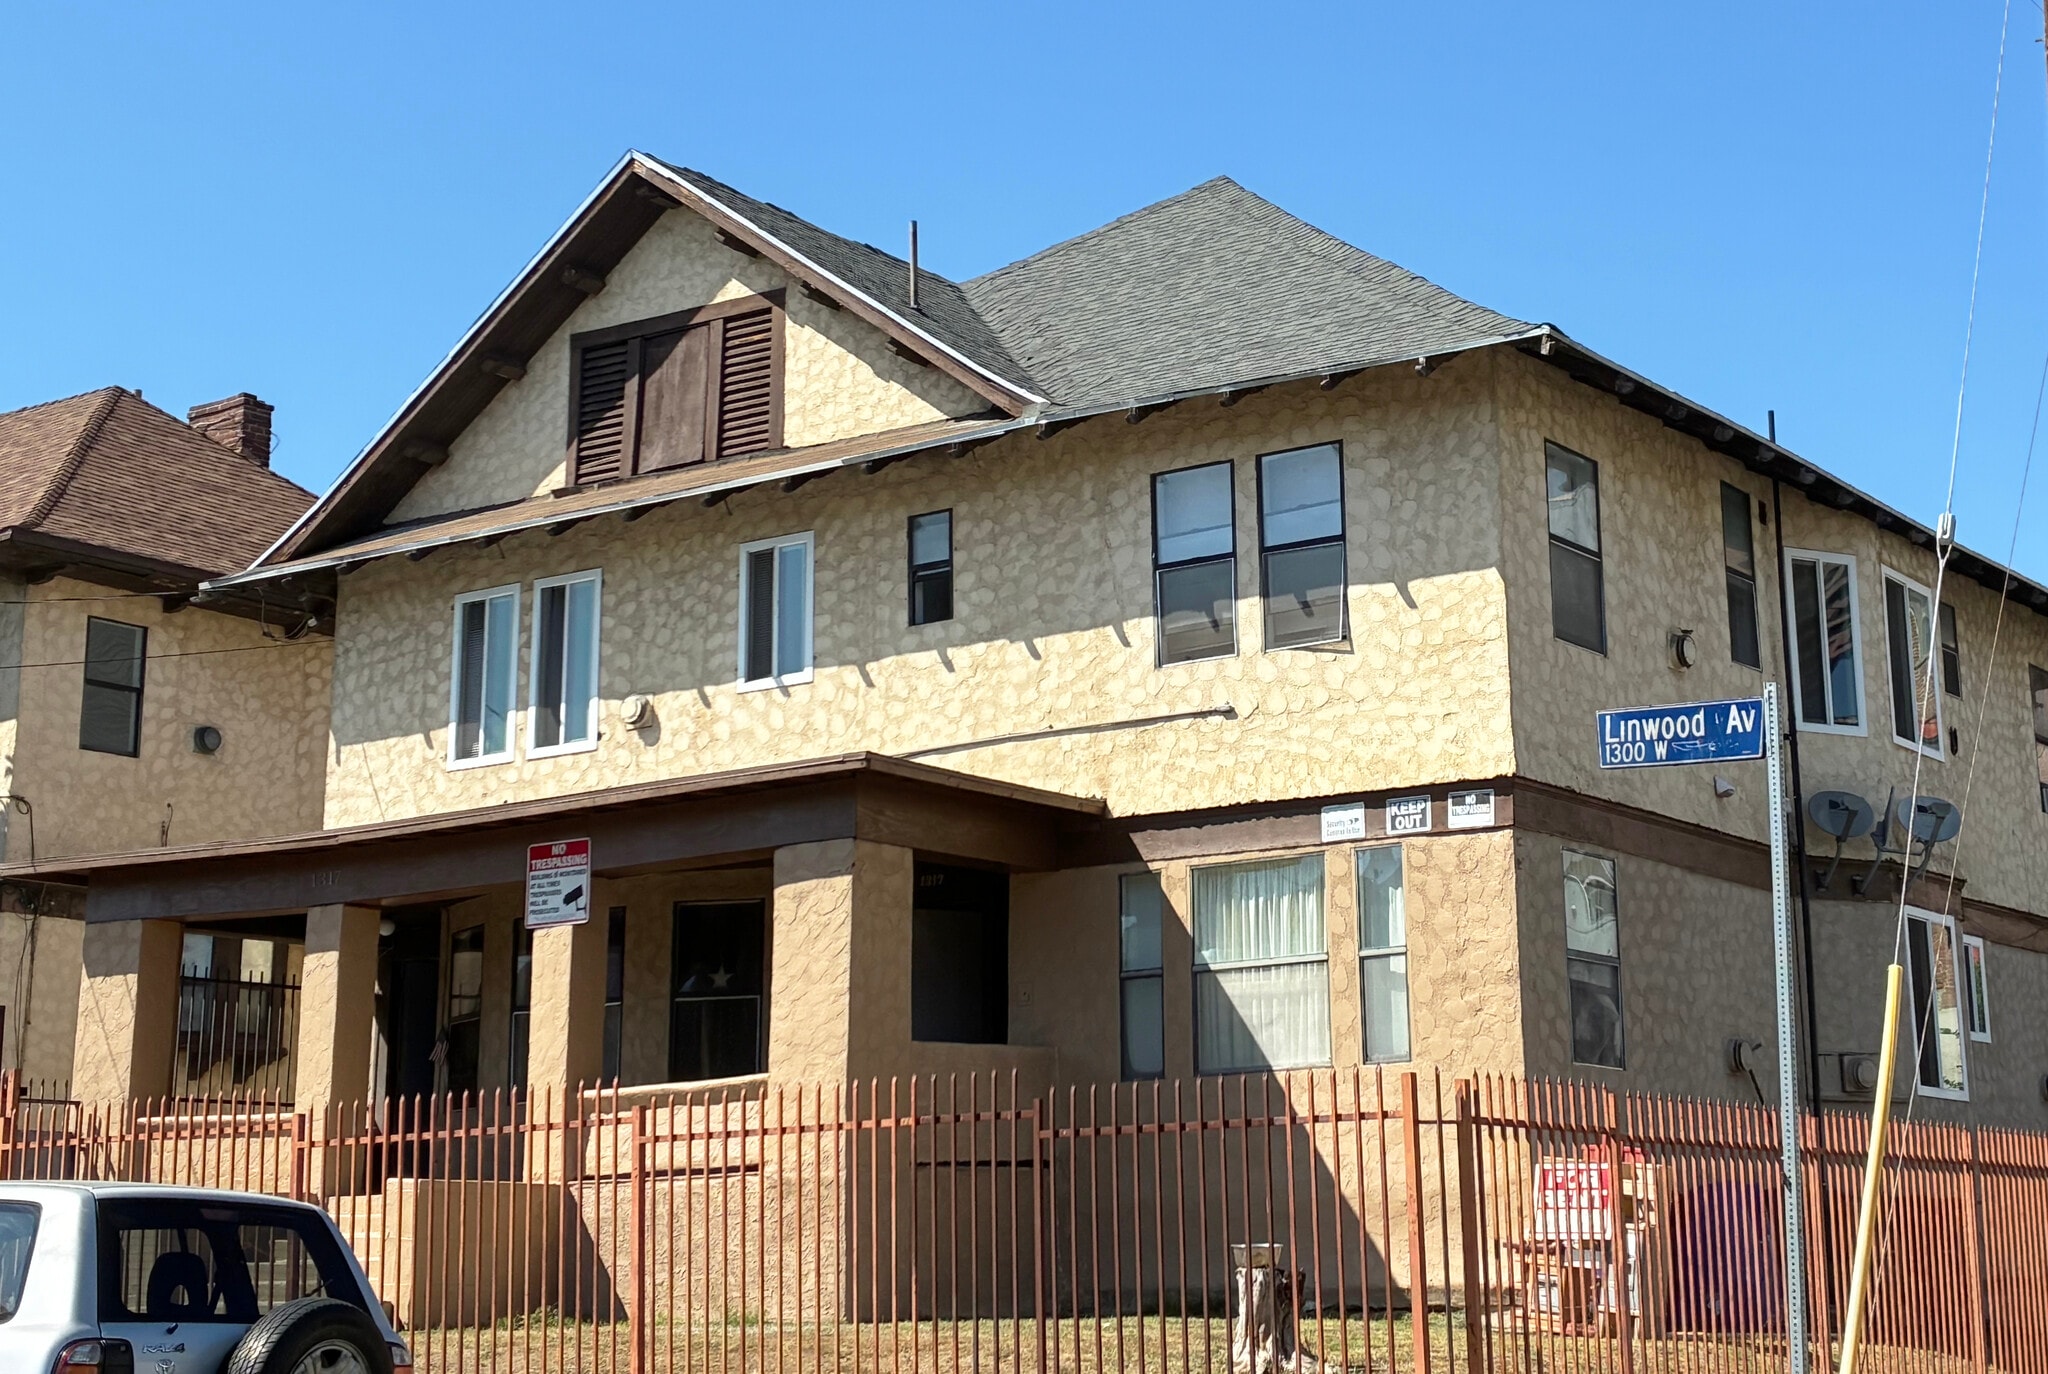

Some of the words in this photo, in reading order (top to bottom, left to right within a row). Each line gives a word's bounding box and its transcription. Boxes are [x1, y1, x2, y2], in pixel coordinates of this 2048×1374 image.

[1605, 707, 1704, 743] Linwood
[1726, 704, 1756, 734] Av
[1605, 742, 1645, 763] 1300
[1654, 740, 1668, 761] W
[1465, 794, 1476, 804] NO
[1391, 799, 1426, 816] KEEP
[1452, 803, 1490, 816] TRESPASSING
[1326, 820, 1345, 828] Security
[1395, 814, 1423, 830] OUT
[551, 844, 567, 855] NO
[531, 854, 588, 870] TRESPASSING
[142, 1342, 185, 1353] RAV4
